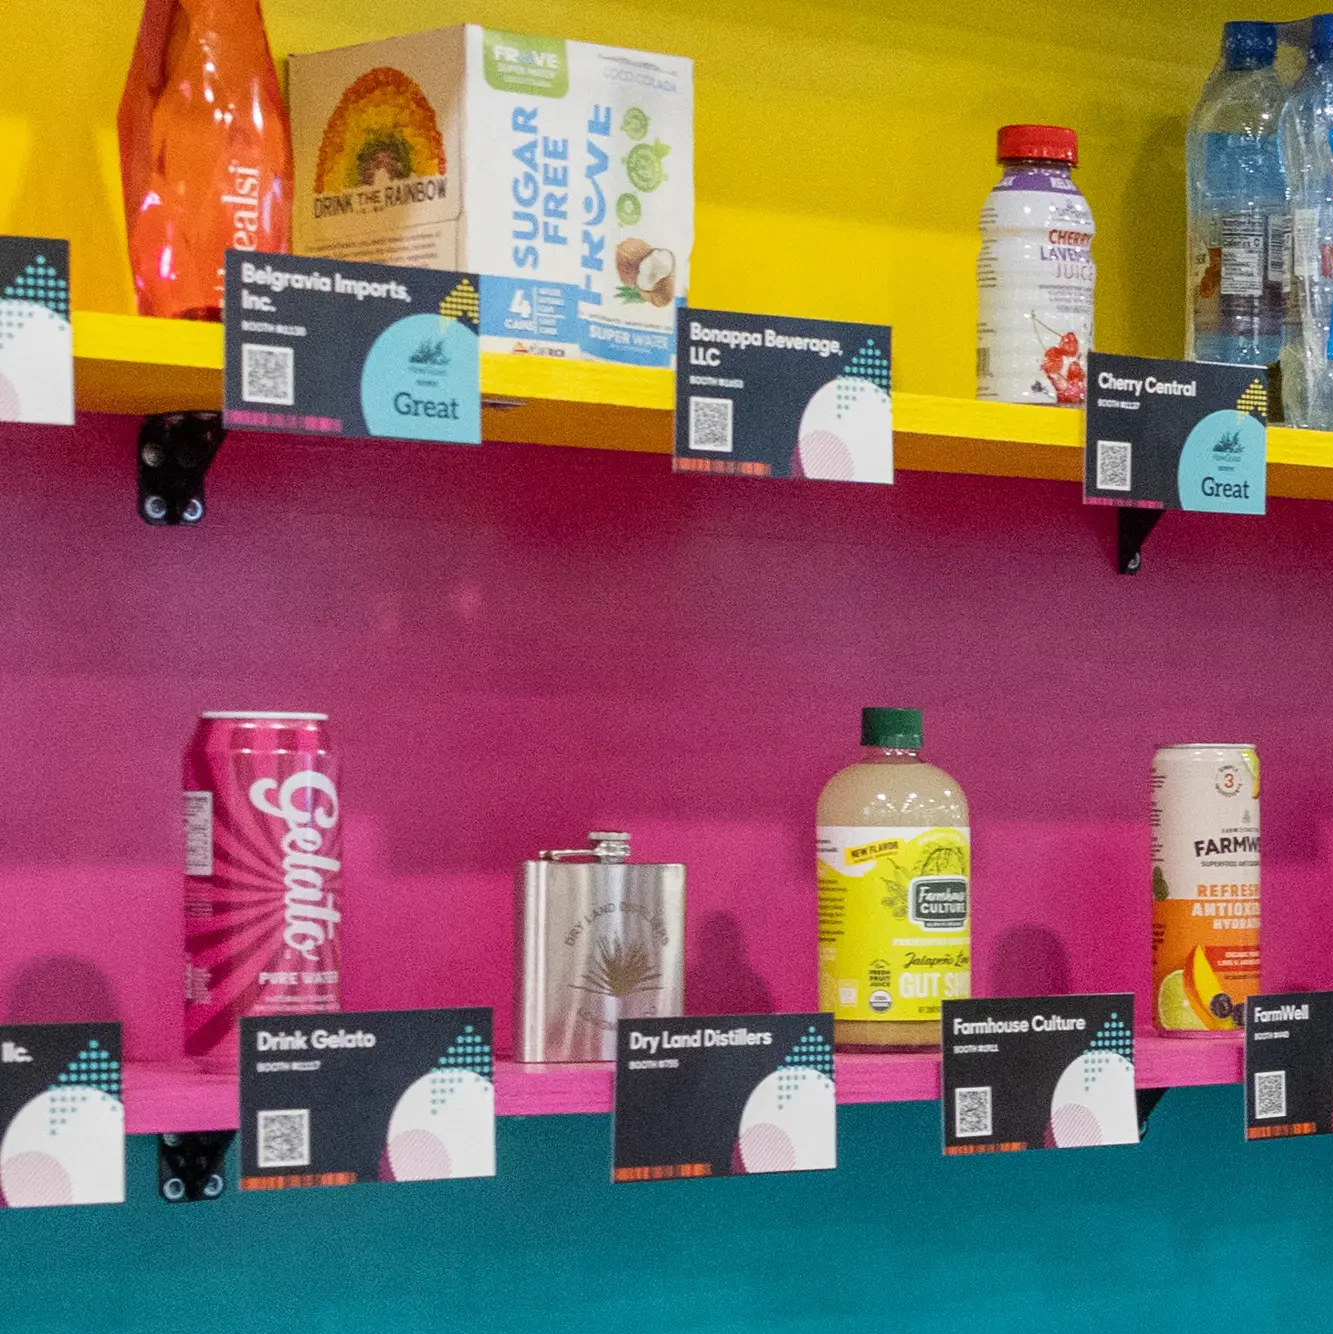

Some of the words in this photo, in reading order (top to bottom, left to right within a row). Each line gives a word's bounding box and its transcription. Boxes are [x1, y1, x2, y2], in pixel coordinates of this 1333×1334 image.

[313, 196, 354, 219] DRINK
[358, 187, 380, 206] THE
[384, 179, 448, 208] RAINBOW
[512, 106, 539, 270] SUGAR
[543, 136, 569, 245] FREE
[241, 262, 332, 292] Belgravia
[334, 273, 412, 303] Imports,
[241, 289, 277, 312] Inc.
[510, 289, 532, 317] 4
[689, 322, 762, 349] Bonappa
[764, 329, 844, 358] Beverage,
[689, 346, 721, 367] LLC
[1098, 371, 1143, 396] Cherry
[1145, 376, 1197, 397] Central
[393, 391, 460, 421] Great
[1201, 476, 1250, 499] Great
[1223, 773, 1234, 788] 3
[249, 769, 341, 962] Gelato
[563, 920, 584, 948] DRY
[900, 972, 941, 998] GUT
[953, 1017, 1029, 1036] Farmhouse
[1032, 1016, 1086, 1033] Culture
[1254, 1006, 1309, 1023] FarmWell
[256, 1030, 307, 1053] Drink
[311, 1029, 376, 1050] Gelato
[629, 1031, 661, 1054] Dry
[661, 1029, 701, 1049] Land
[704, 1028, 773, 1048] Distillers
